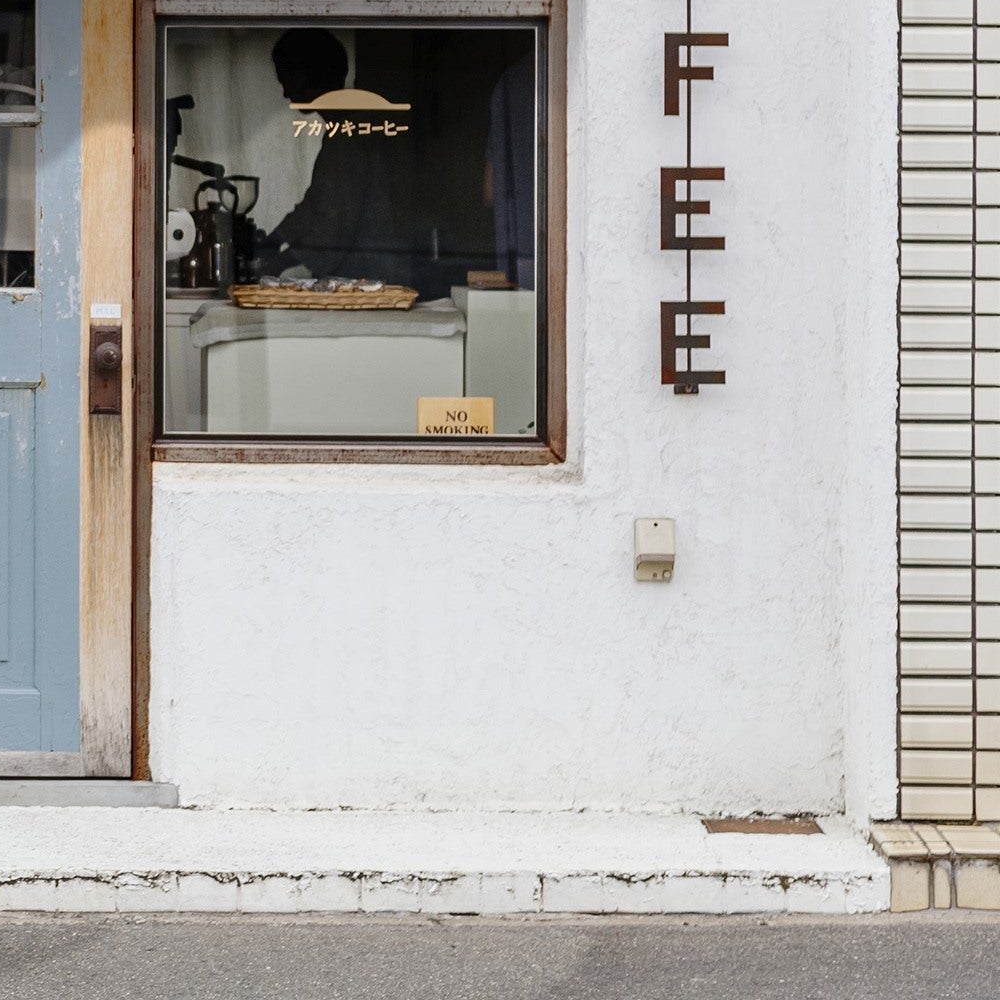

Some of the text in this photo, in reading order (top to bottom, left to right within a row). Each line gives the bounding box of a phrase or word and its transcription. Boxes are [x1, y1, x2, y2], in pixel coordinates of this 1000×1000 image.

[292, 119, 409, 138] アカツキコーヒー
[445, 410, 468, 422] NO
[424, 424, 489, 435] SMOKING
